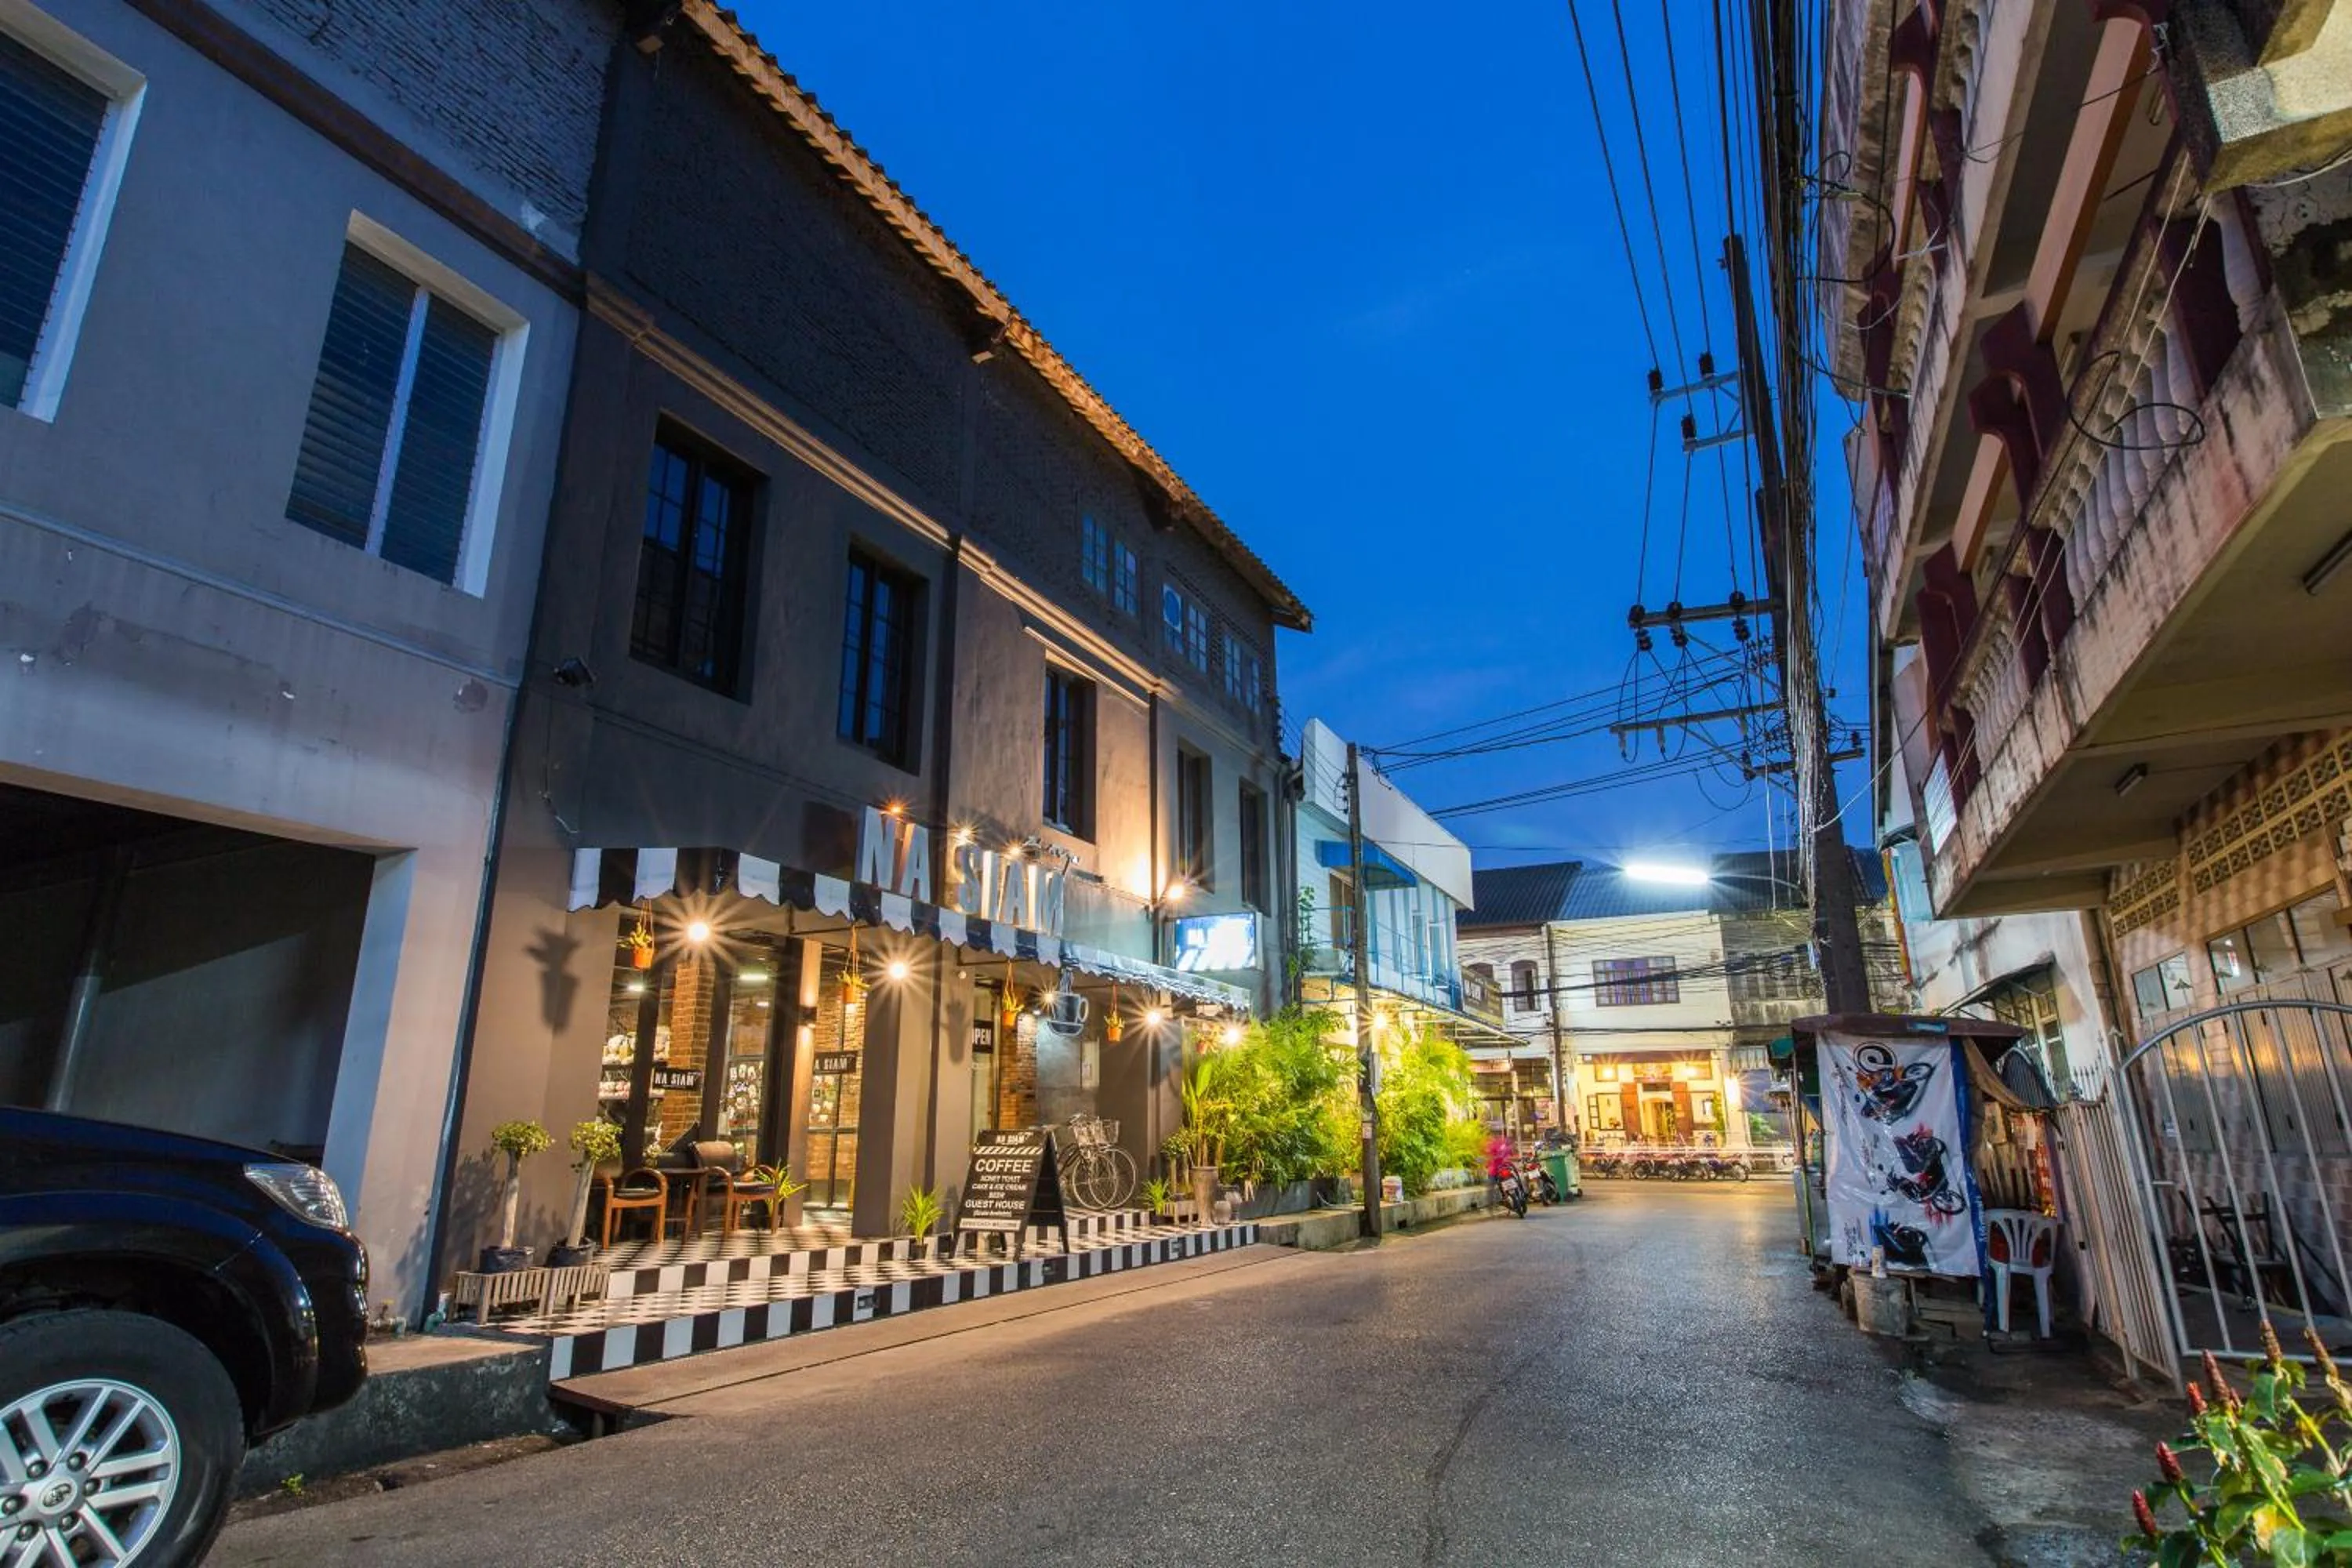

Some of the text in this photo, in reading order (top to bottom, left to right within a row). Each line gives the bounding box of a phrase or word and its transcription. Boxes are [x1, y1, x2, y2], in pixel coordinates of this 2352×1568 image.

[858, 805, 1065, 937] NA SIAM
[972, 1028, 992, 1044] PEN
[655, 1073, 695, 1087] NA SIAM
[975, 1159, 1033, 1172] COFFEE
[965, 1200, 1025, 1210] GUEST HOUSE
